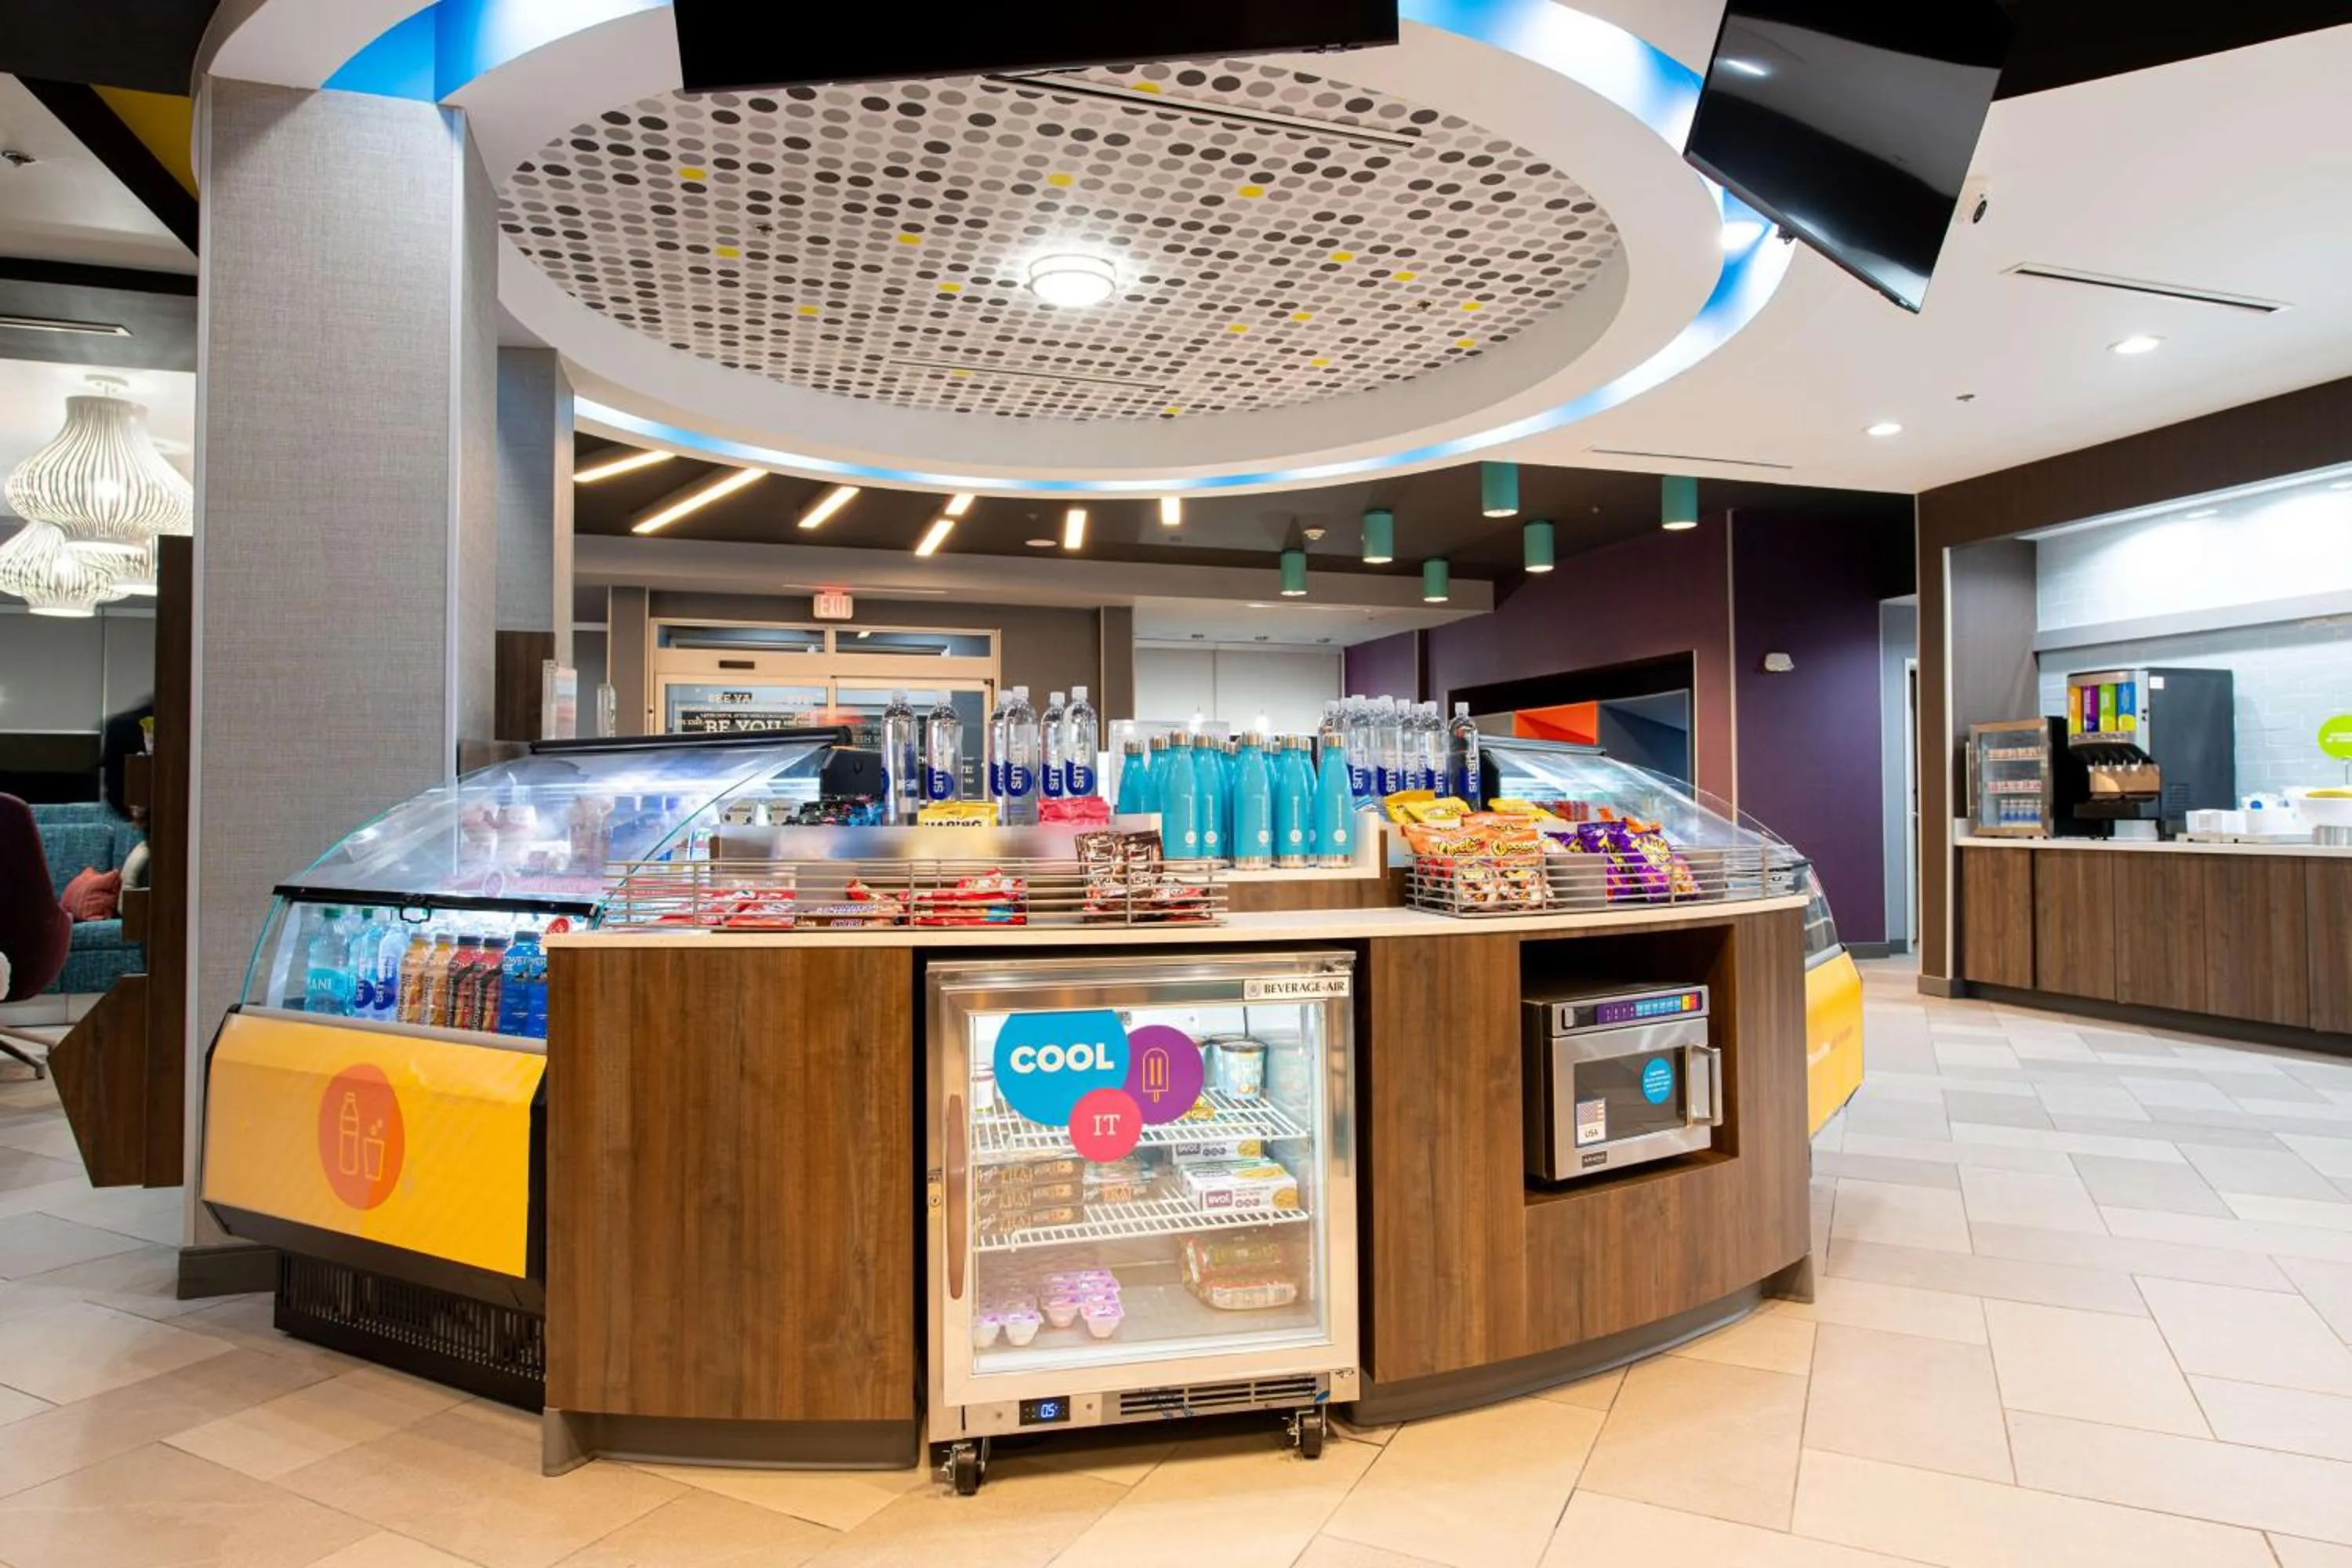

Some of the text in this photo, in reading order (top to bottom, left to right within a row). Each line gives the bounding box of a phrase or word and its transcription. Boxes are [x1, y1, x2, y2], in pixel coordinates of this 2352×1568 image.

[820, 595, 849, 616] EXIT
[1264, 981, 1345, 994] BEVERAGE-AIR
[1010, 1042, 1115, 1074] COOL
[1093, 1113, 1121, 1136] IT
